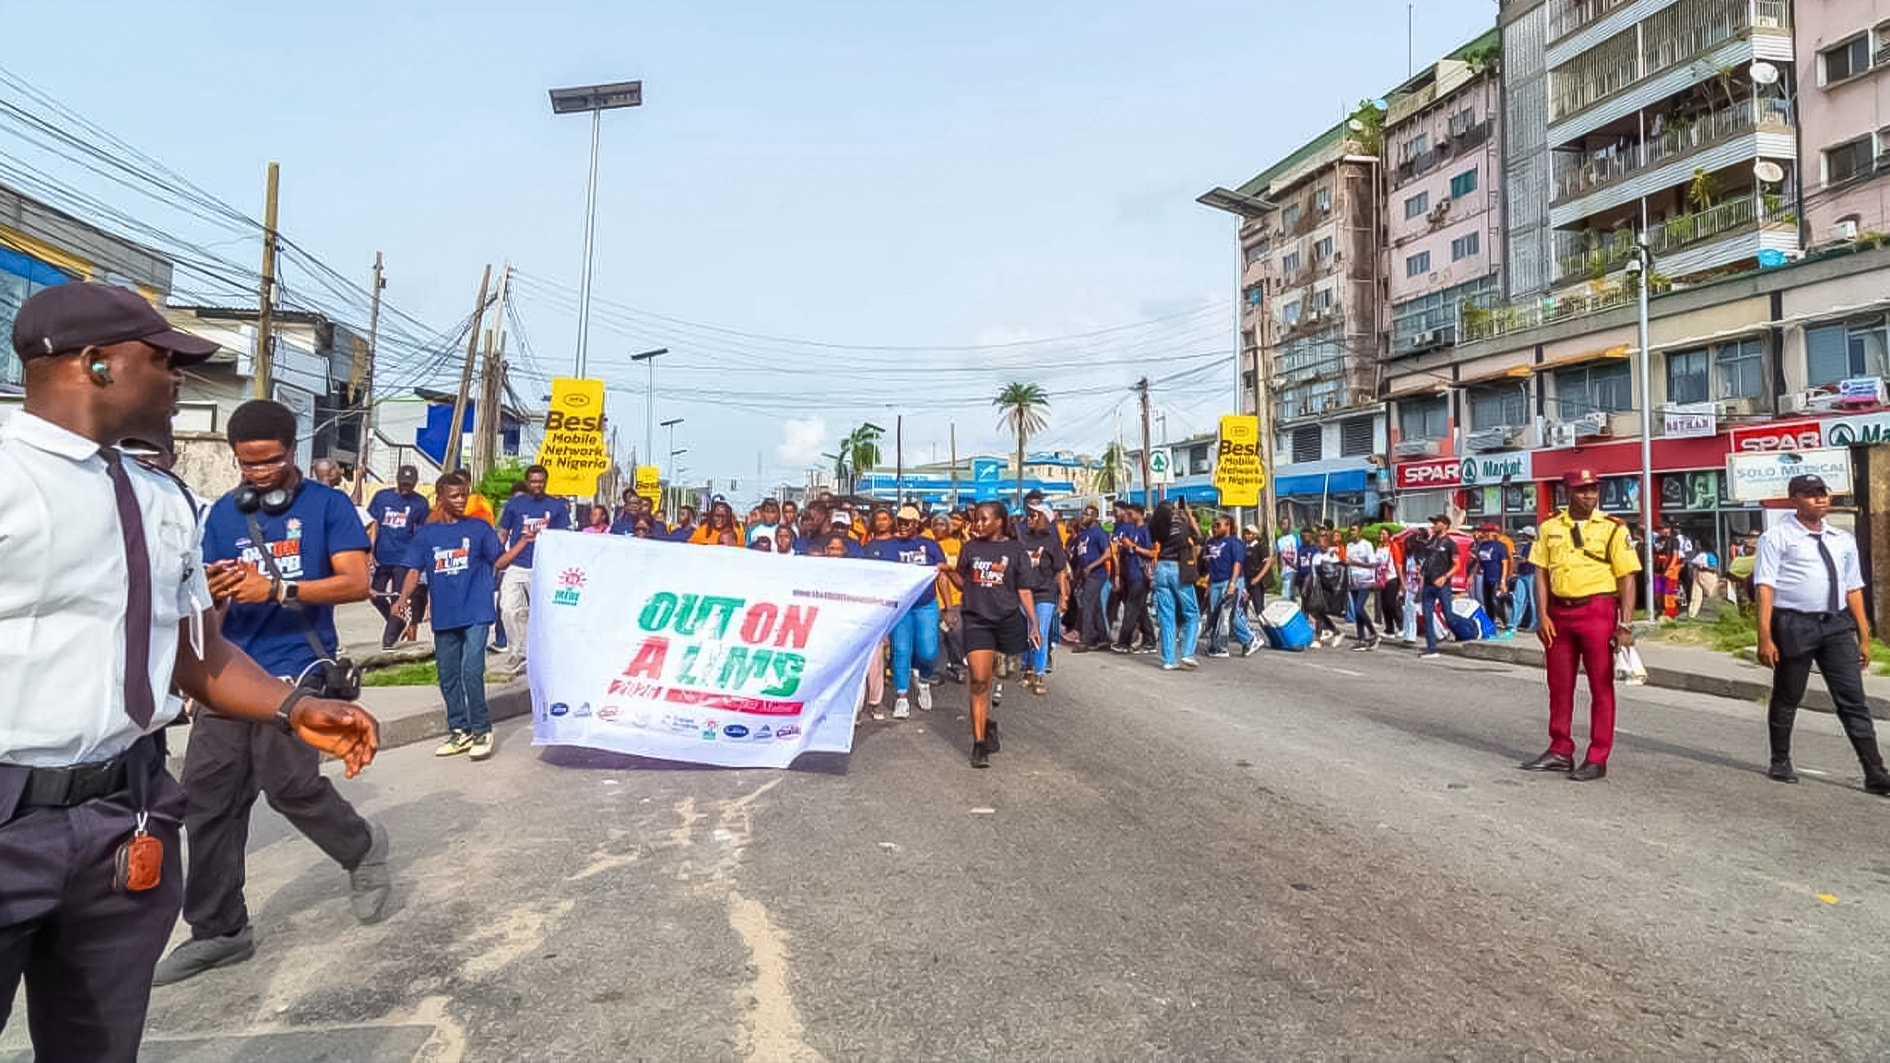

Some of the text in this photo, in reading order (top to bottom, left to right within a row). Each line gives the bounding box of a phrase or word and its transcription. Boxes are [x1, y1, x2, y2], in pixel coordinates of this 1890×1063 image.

[545, 411, 605, 432] Best
[552, 433, 598, 445] Mobile
[1740, 431, 1820, 451] SPAR
[545, 444, 604, 457] Network
[1219, 440, 1260, 456] Best
[556, 457, 607, 470] Nigeria
[1224, 456, 1256, 466] Mobile
[1404, 459, 1522, 483] SPAR Market
[1737, 463, 1844, 478] SOLO MEDICAL
[637, 591, 820, 649] OUT ON
[622, 636, 671, 680] A
